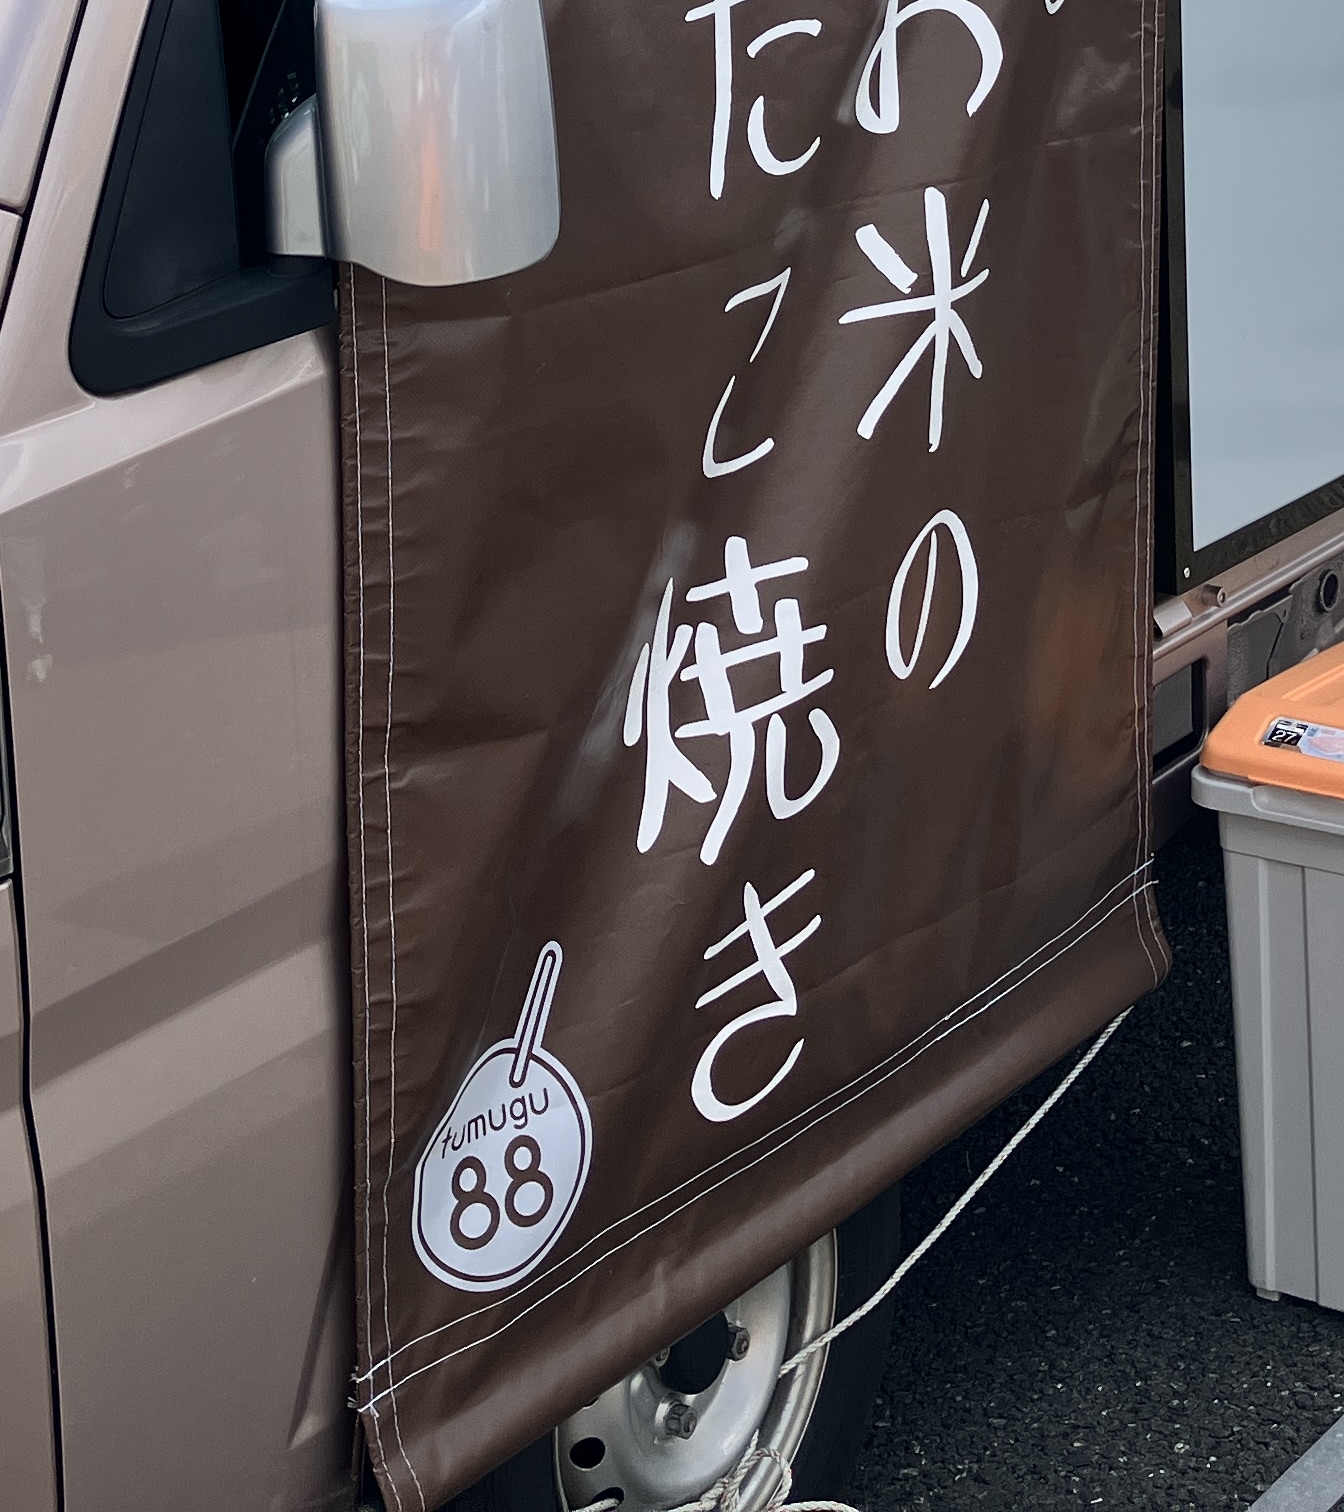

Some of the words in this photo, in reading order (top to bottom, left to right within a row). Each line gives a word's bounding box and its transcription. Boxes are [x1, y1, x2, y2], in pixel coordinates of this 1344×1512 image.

[1271, 729, 1298, 743] 27
[441, 1087, 550, 1160] tumugu
[449, 1134, 554, 1251] 88
